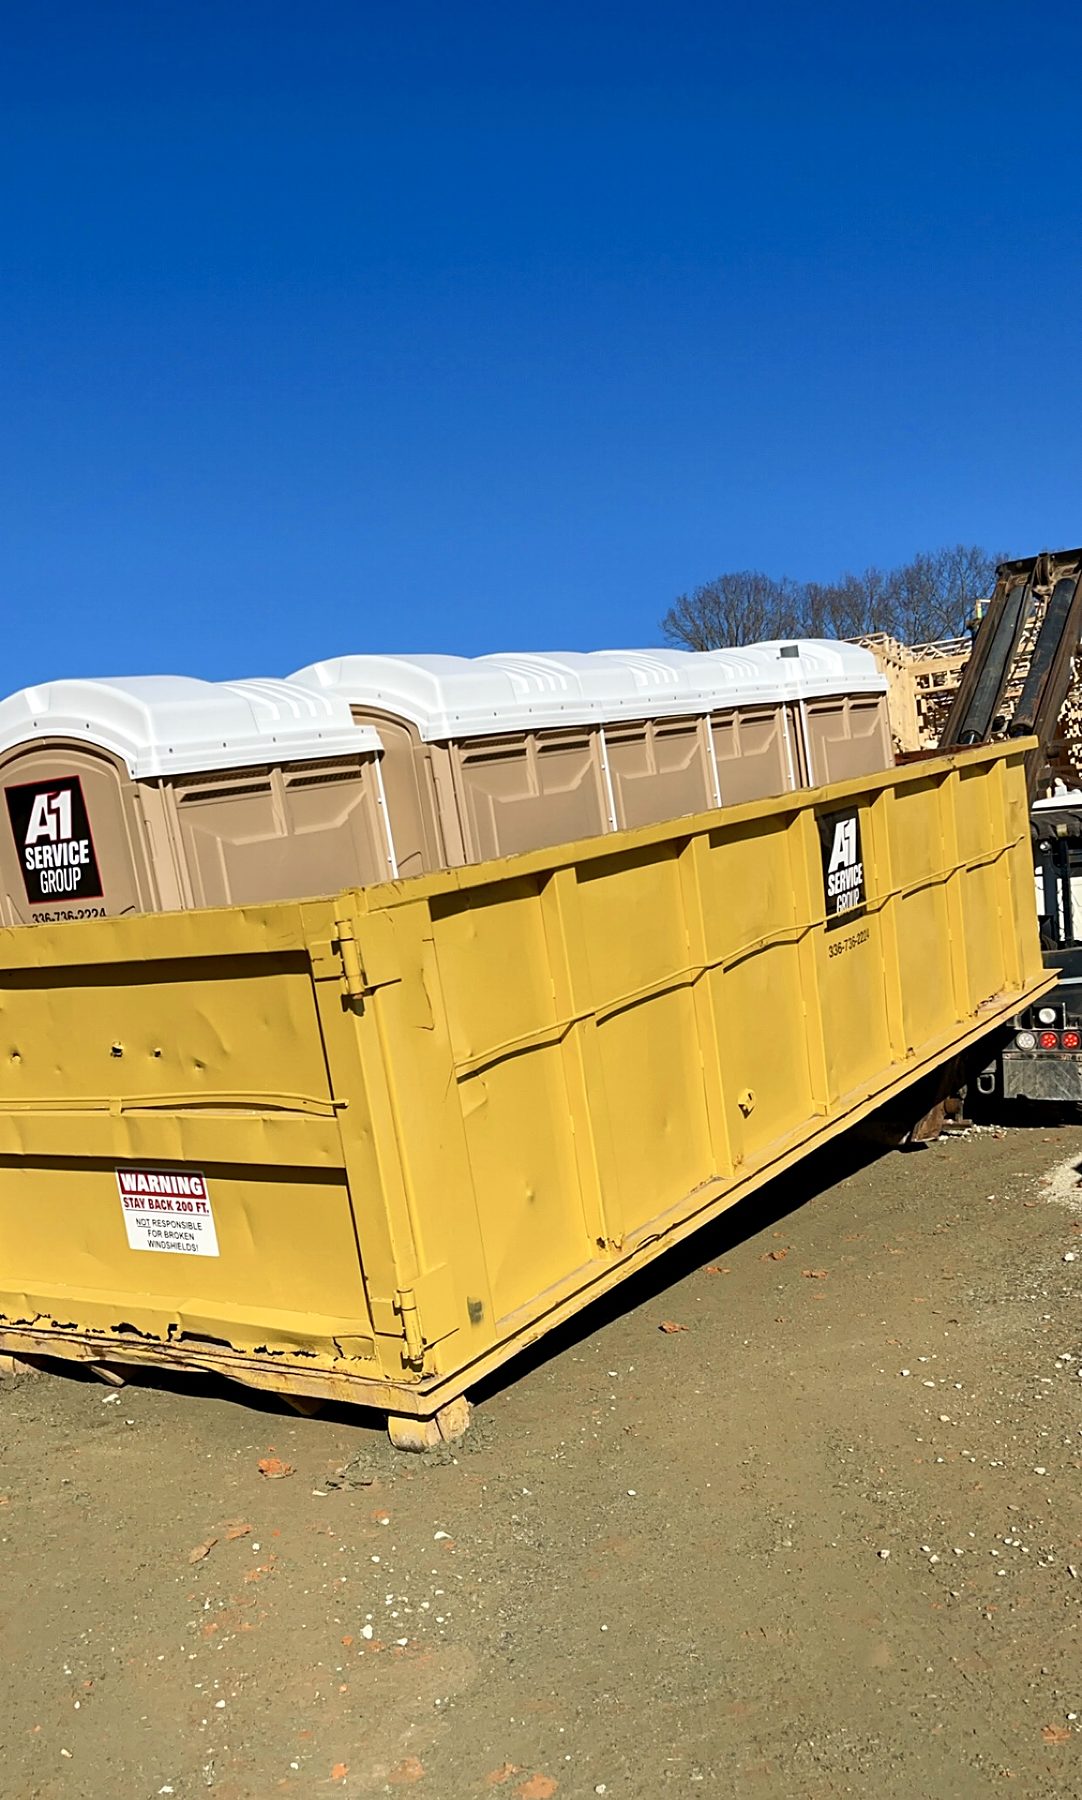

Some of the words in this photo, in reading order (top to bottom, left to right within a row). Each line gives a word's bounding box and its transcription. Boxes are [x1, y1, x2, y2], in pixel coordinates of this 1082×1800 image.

[25, 789, 72, 845] A1
[25, 840, 90, 870] SERVICE
[828, 817, 857, 873] A1
[40, 867, 82, 893] GROUP
[827, 862, 863, 897] SERVICE
[836, 887, 860, 917] GROUP
[828, 928, 870, 958] 336-736-2224
[120, 1173, 204, 1195] WARNING
[123, 1197, 145, 1209] STAY
[148, 1199, 174, 1210] BACK
[175, 1201, 193, 1212] 200
[196, 1202, 210, 1213] FT.
[136, 1218, 151, 1228] NOT
[152, 1219, 203, 1231] RESPONSIBLE
[148, 1230, 162, 1238] FOR
[164, 1231, 195, 1241] BROKEN
[147, 1240, 199, 1252] WINDSHIELDS!
